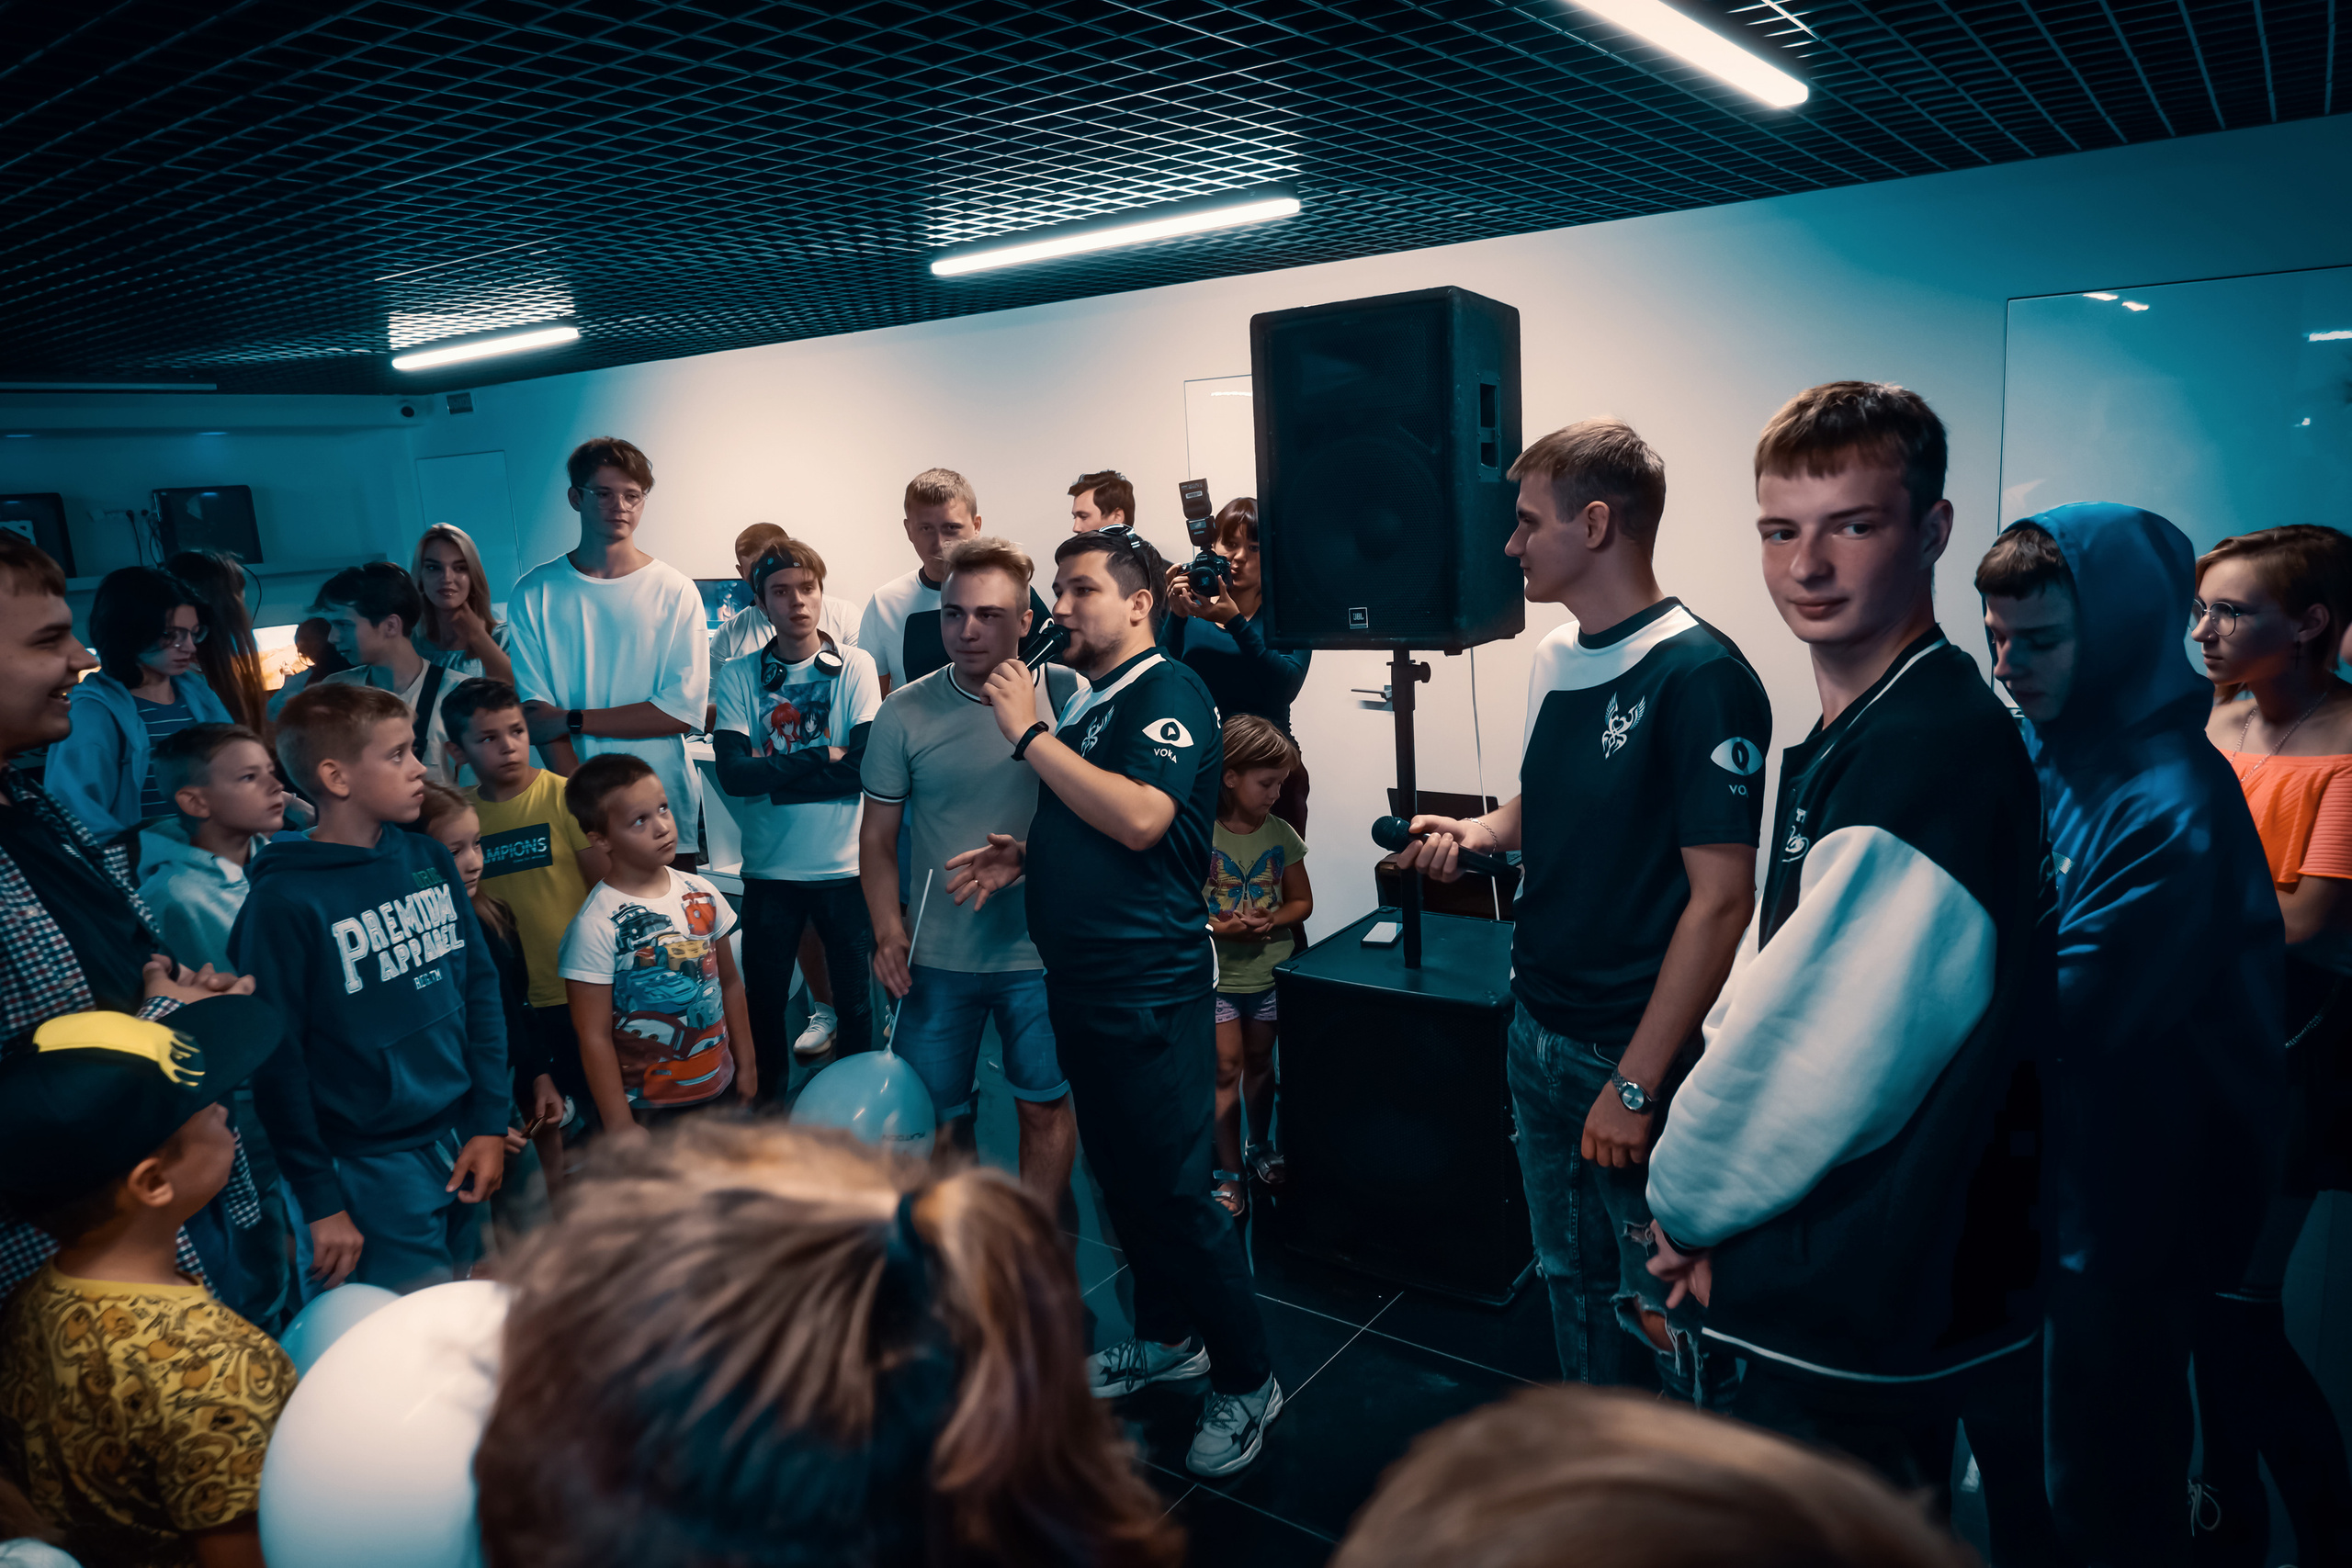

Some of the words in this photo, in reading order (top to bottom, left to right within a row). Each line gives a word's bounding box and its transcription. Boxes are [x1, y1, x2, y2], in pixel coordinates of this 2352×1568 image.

[1154, 748, 1177, 763] VOKA
[332, 883, 458, 994] PREMIUM
[378, 923, 465, 982] APPAREL
